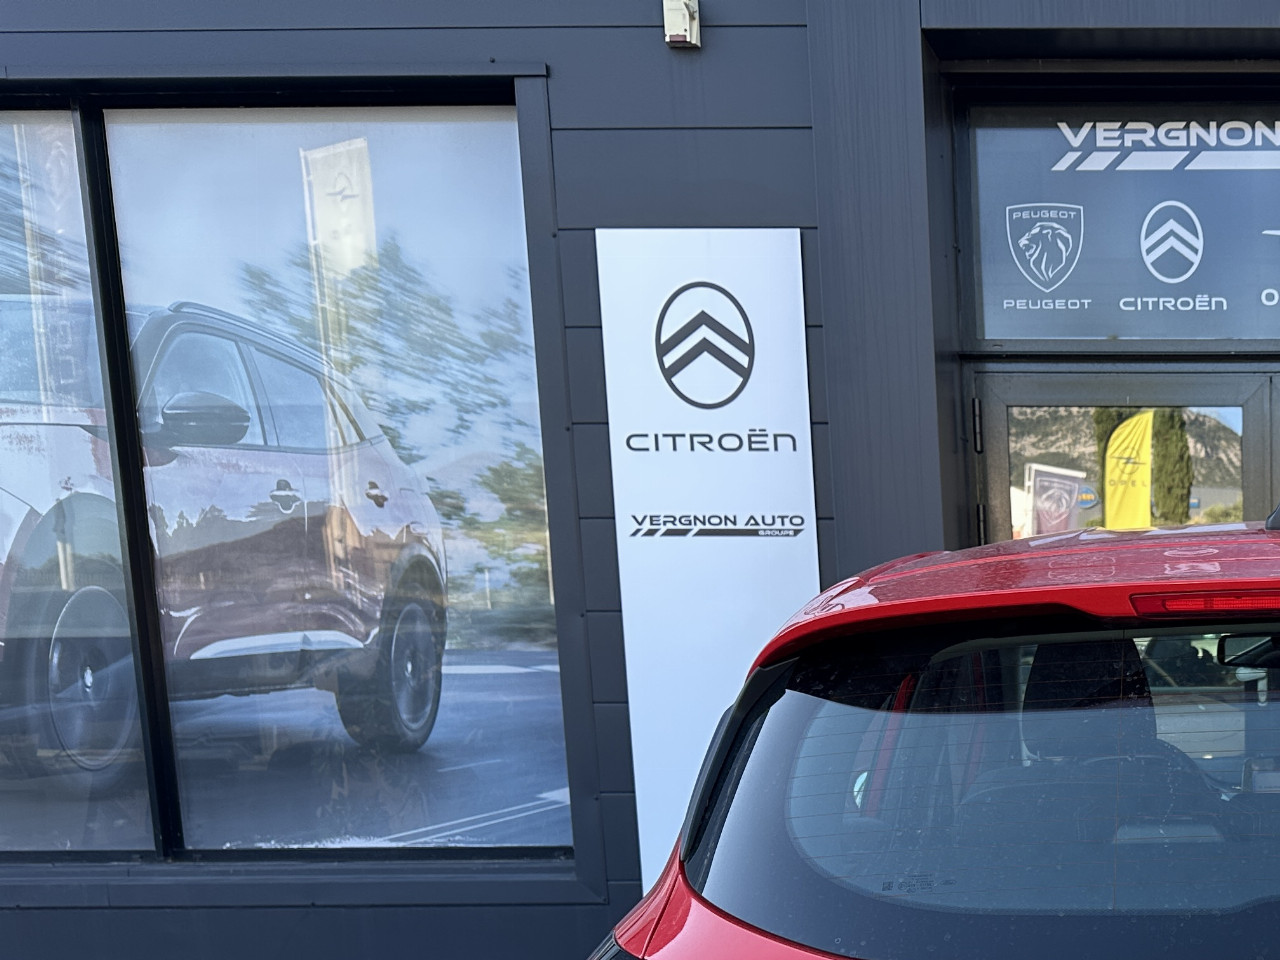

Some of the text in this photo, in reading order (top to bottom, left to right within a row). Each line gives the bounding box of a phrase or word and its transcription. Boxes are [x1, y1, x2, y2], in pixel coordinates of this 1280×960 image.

[1012, 209, 1077, 220] PEUGEOT
[1003, 299, 1092, 310] PEUGEOT
[1119, 294, 1228, 311] CITROËN
[625, 428, 798, 452] CITROËN
[631, 514, 805, 527] VERGNON AUTO
